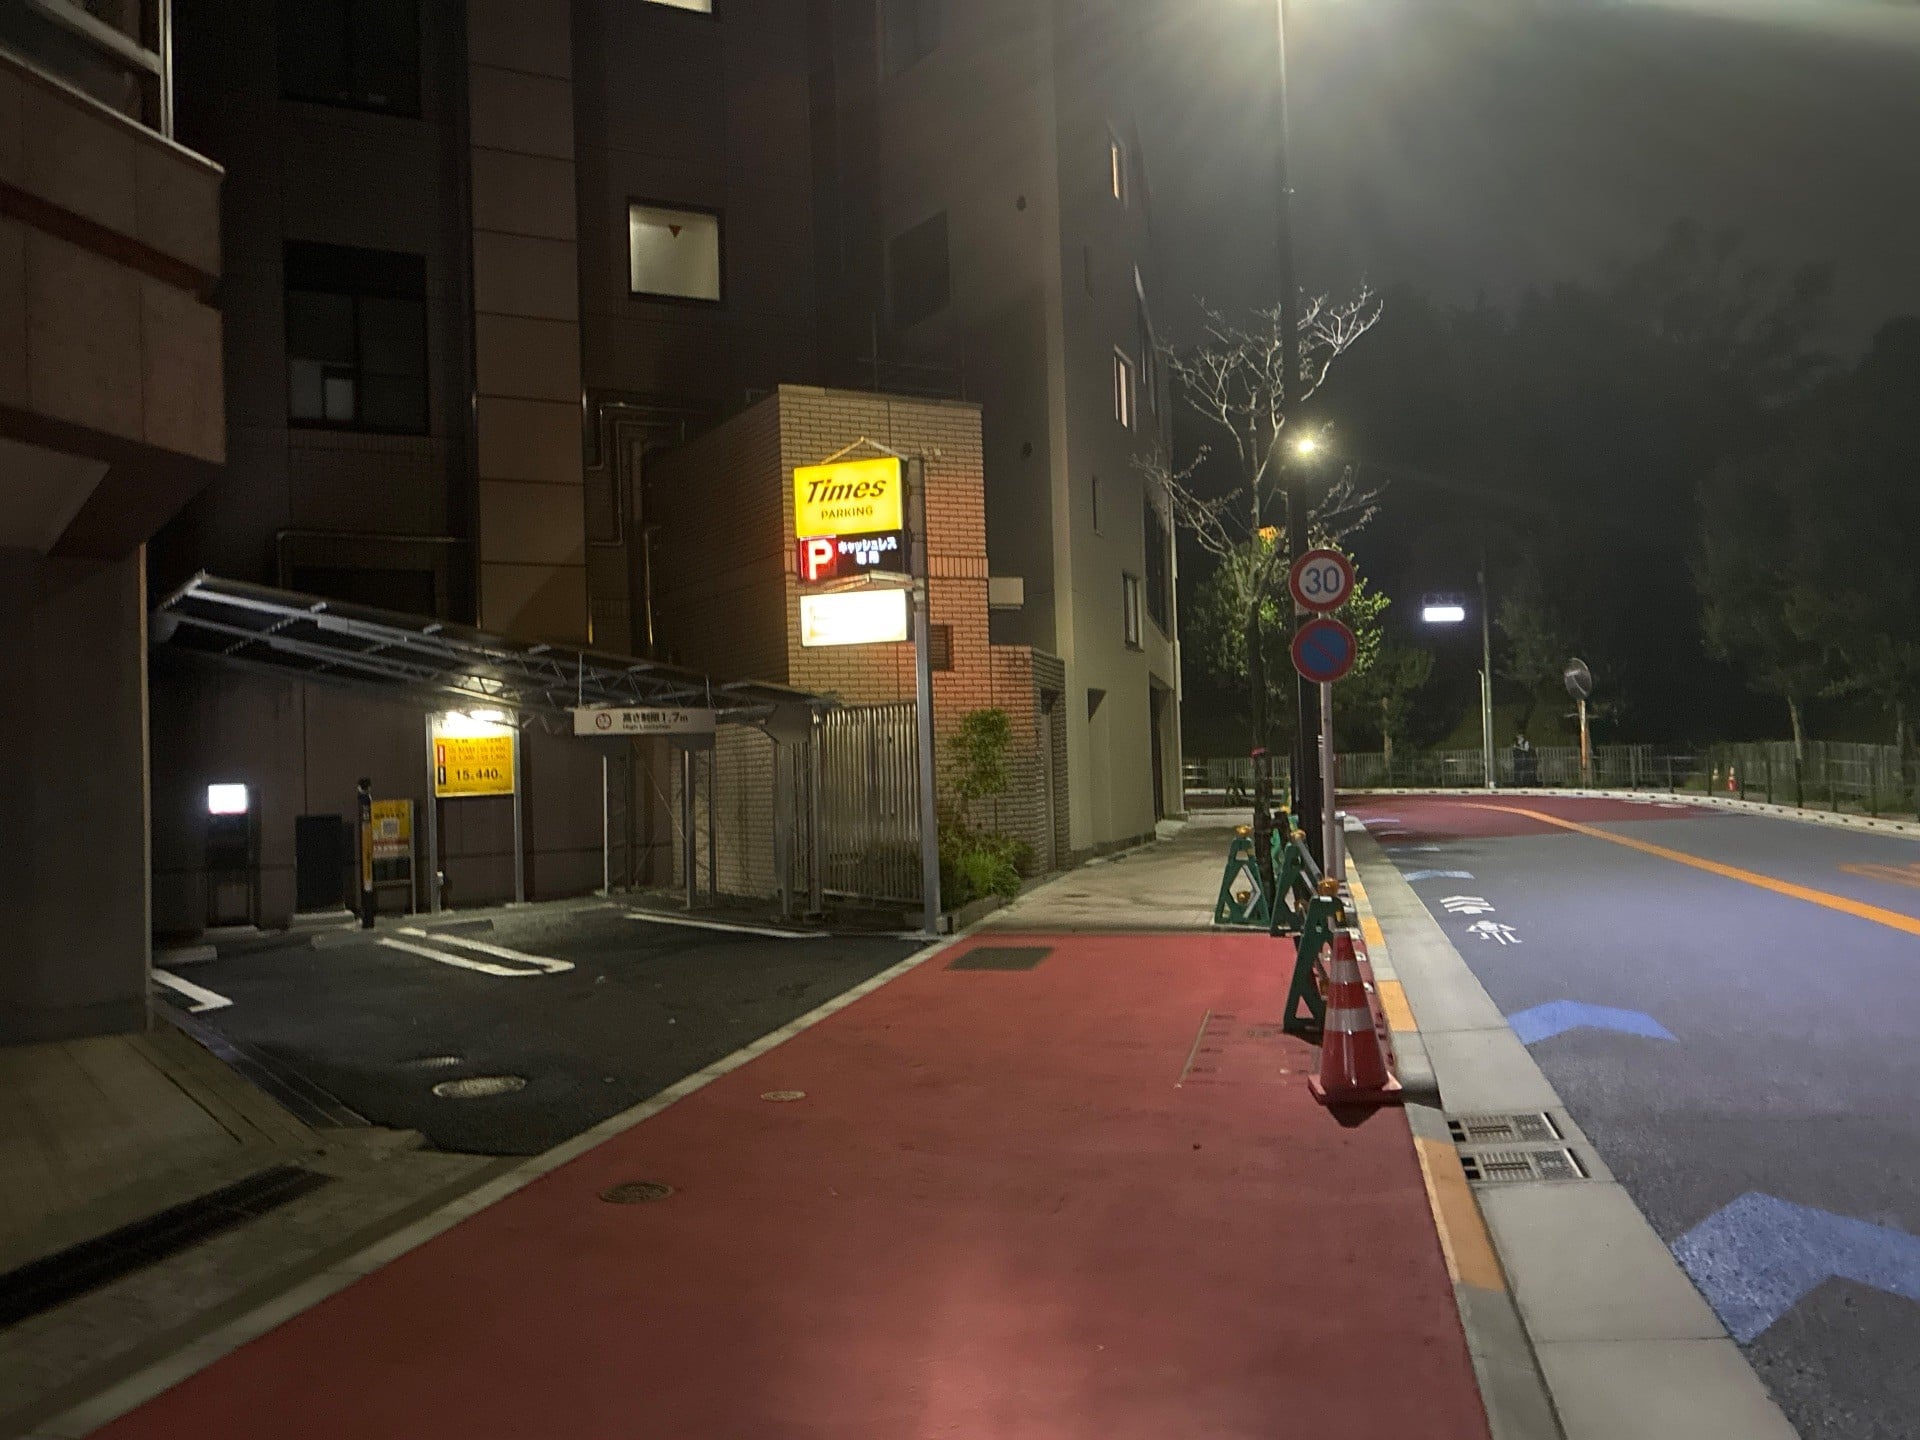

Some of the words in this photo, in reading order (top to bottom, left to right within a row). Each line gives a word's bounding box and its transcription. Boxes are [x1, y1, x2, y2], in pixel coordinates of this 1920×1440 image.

[807, 479, 887, 503] Times
[821, 506, 873, 520] PARKING
[808, 539, 833, 580] P
[1305, 566, 1340, 595] 30
